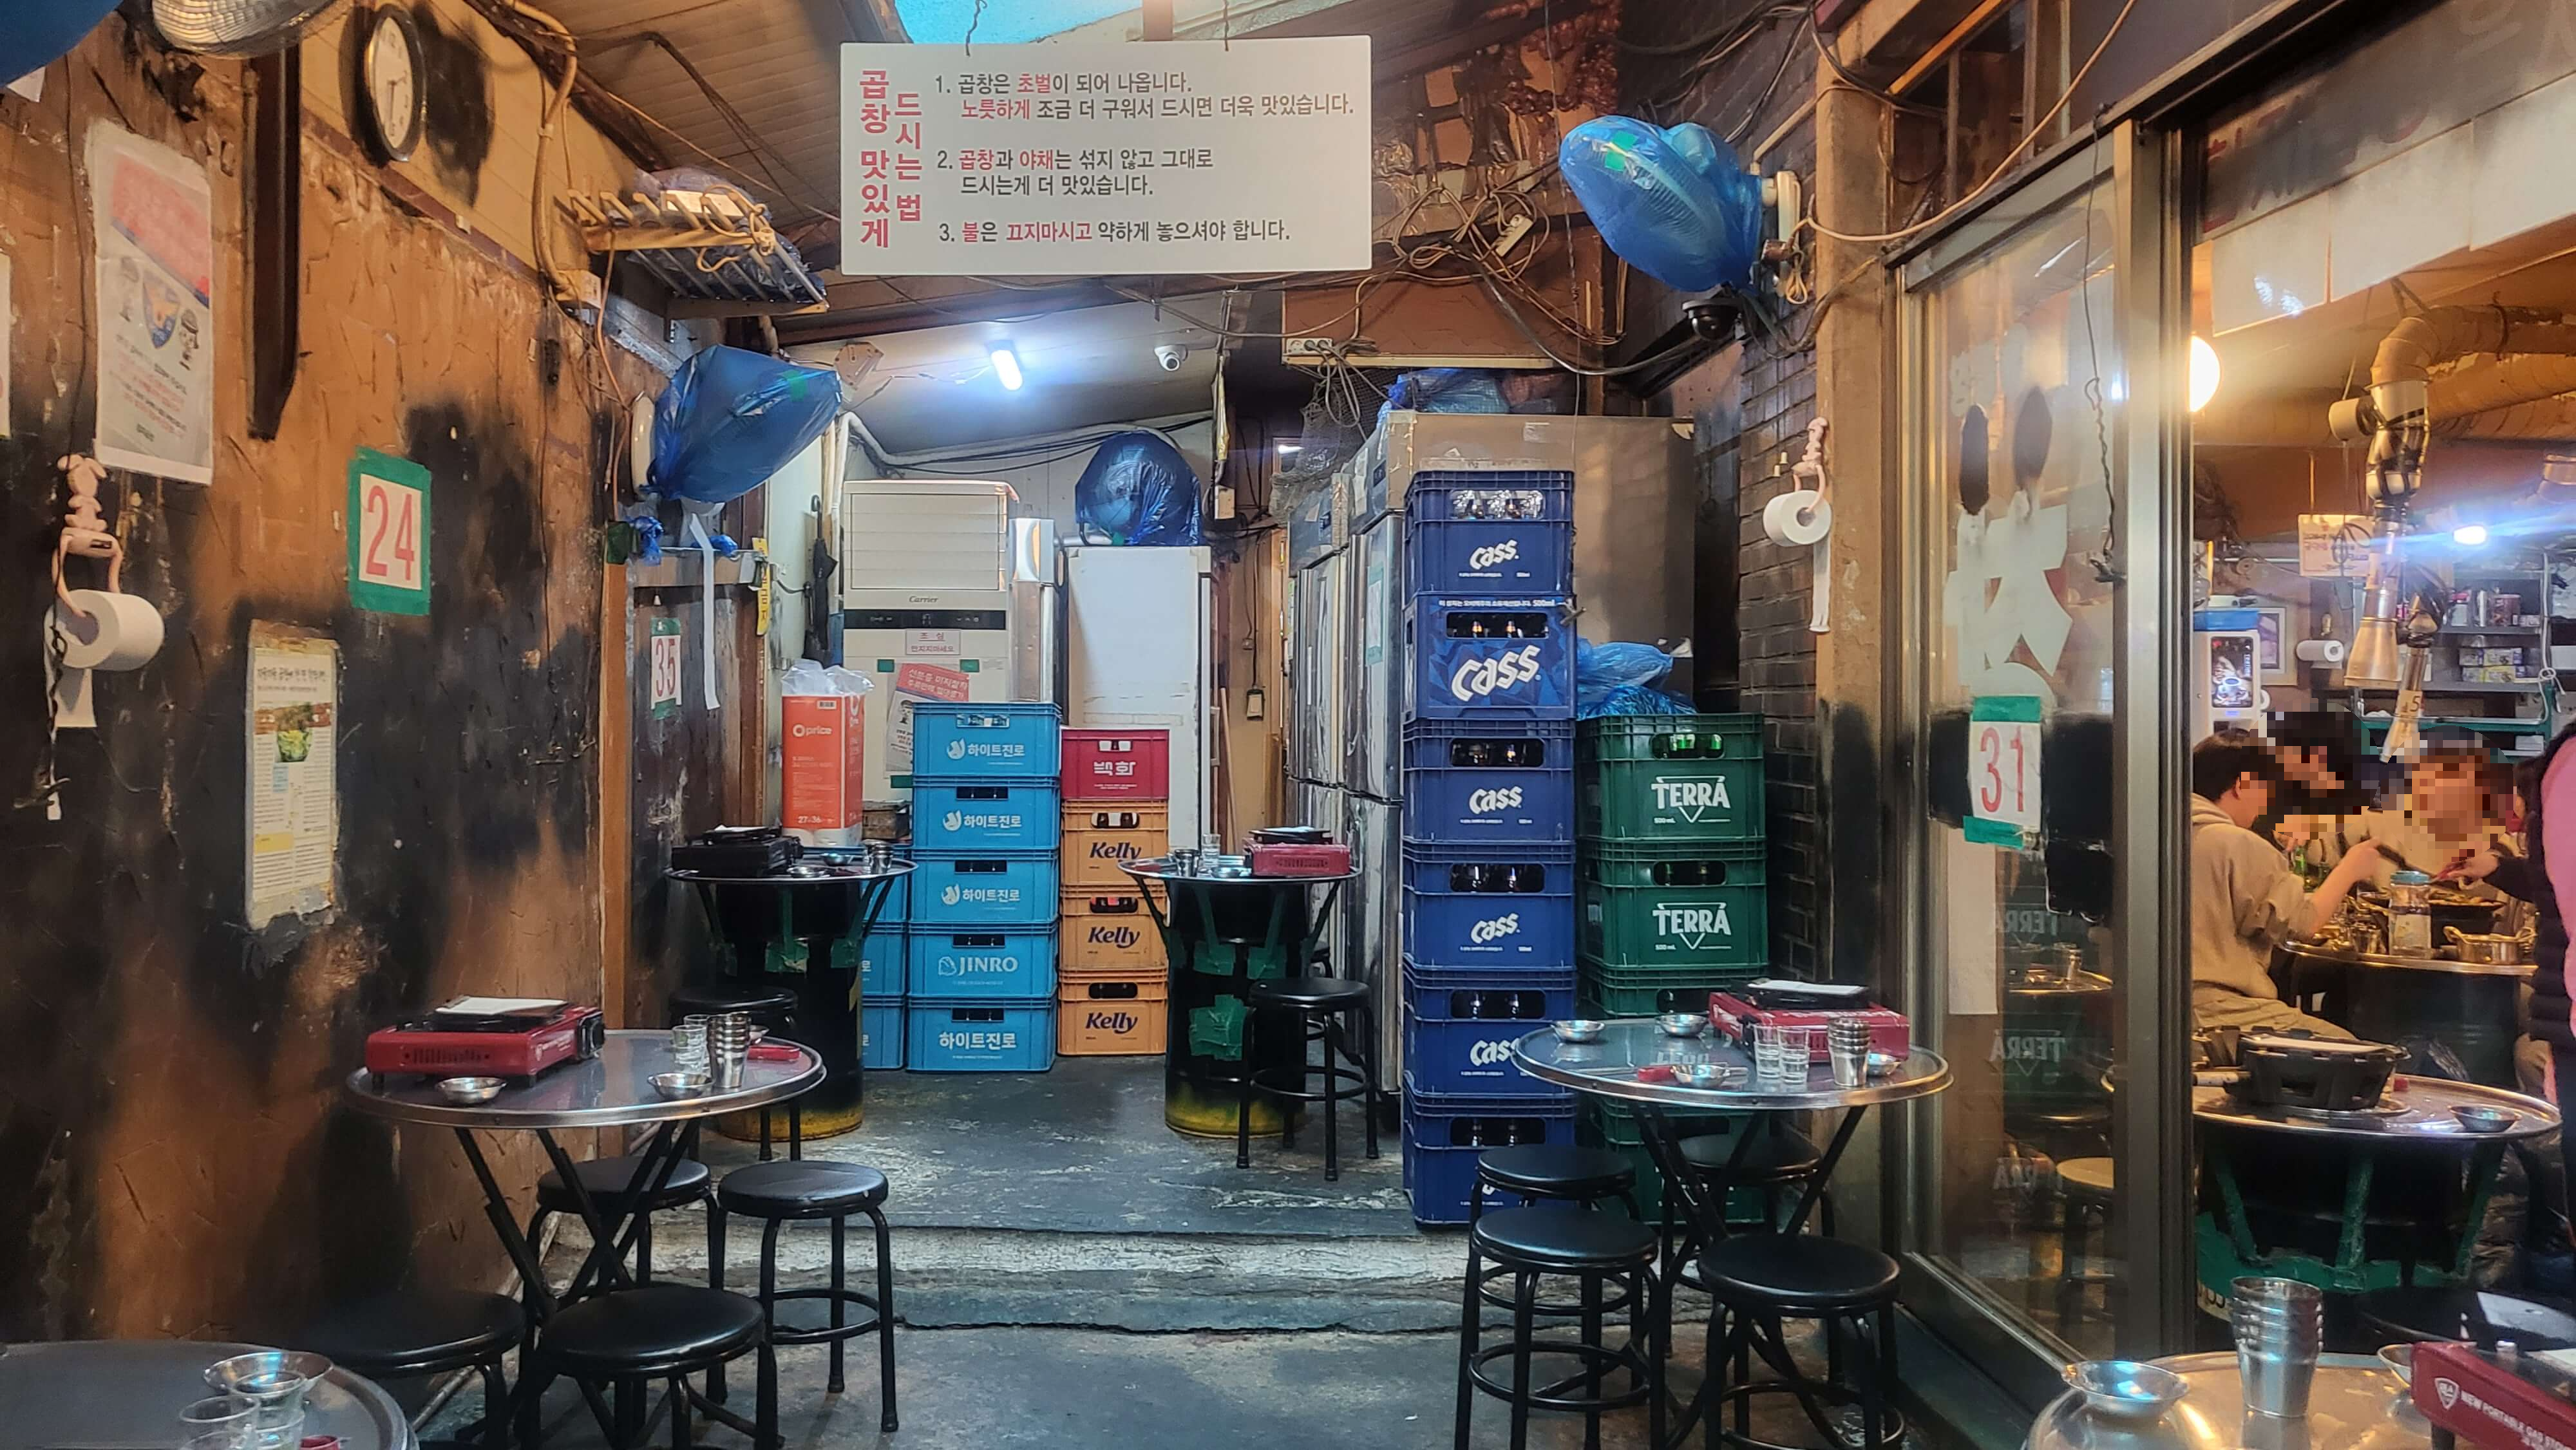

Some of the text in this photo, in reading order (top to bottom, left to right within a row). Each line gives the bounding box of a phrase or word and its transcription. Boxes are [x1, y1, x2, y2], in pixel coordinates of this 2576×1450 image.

[935, 71, 1192, 95] 1. 곱창은 초벌이 되어 나옵니다.
[961, 94, 1353, 120] 노릇하게 조금 더 구워서 드시면 더욱 맛있습니다.
[860, 70, 890, 248] 곱창 맛있게
[894, 93, 923, 221] 드시는 법
[937, 148, 1213, 171] 2. 곱창과 야채는 섞지 않고 그대로
[960, 174, 1153, 197] 드시는게 더 맛있습니다.
[939, 219, 1290, 243] 3. 불은 끄지마시고 약하게 놓으셔야 합니다.
[366, 485, 415, 581] 24
[1470, 539, 1519, 570] Cass
[908, 595, 939, 604] Carrier
[655, 638, 677, 697] 35
[1451, 644, 1541, 702] Cass
[968, 743, 1025, 758] 하이트진로
[1980, 725, 2024, 813] 31
[1469, 786, 1523, 815] Cass
[1651, 781, 1731, 810] TERRA
[963, 815, 1022, 828] 하이트진로
[1090, 841, 1142, 862] Kelly
[963, 889, 1021, 902] 하이트진로
[1470, 912, 1519, 944] Cass
[1652, 908, 1732, 936] TERRA
[1088, 926, 1140, 949] Kelly
[958, 956, 1018, 976] JINRO
[1085, 1012, 1139, 1034] Kelly
[939, 1031, 1017, 1050] 하이트진로
